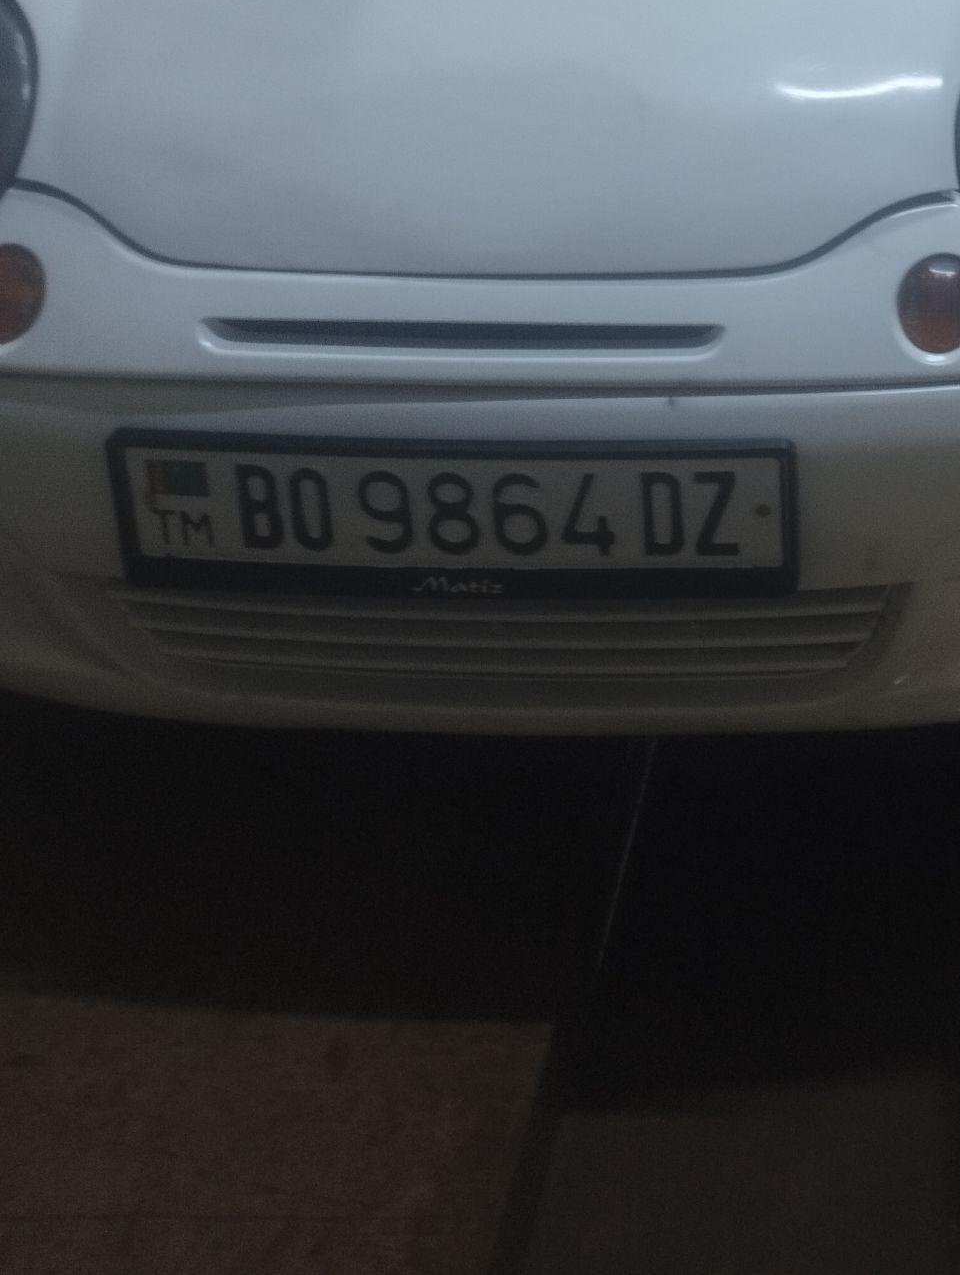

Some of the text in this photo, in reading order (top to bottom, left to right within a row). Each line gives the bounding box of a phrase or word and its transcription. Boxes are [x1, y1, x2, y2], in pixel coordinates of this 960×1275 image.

[150, 508, 215, 547] TM
[357, 469, 616, 557] 9864
[640, 470, 741, 556] DZ
[411, 575, 505, 594] Matiz
